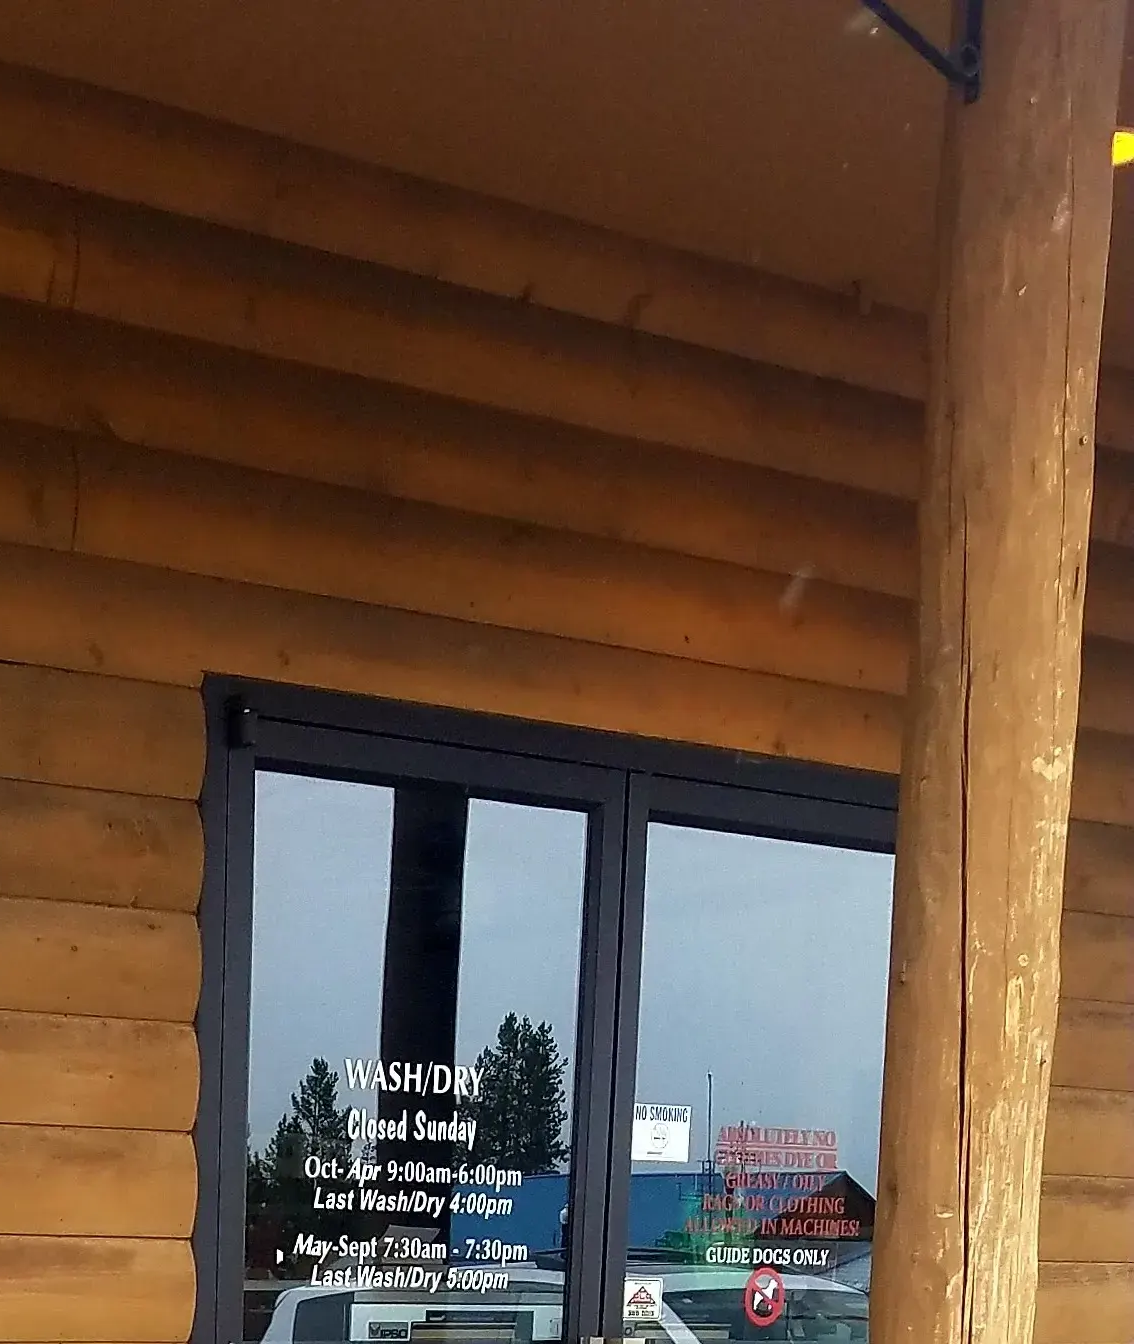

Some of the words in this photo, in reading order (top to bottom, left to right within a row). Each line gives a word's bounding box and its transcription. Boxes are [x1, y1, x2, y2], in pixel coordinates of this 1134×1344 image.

[344, 1058, 485, 1097] WASH/DRY
[635, 1105, 647, 1121] NO
[650, 1106, 688, 1123] SMOKING
[347, 1108, 407, 1142] Closed
[413, 1109, 477, 1151] Sunday
[313, 1187, 354, 1210] Last
[360, 1189, 446, 1219] Wash/Dry
[449, 1192, 513, 1219] 4:00pm
[745, 1195, 765, 1212] OR
[769, 1195, 846, 1215] CLOTHING
[760, 1218, 778, 1236] IN
[780, 1218, 861, 1238] MACHINES!
[292, 1233, 378, 1265] May-Sept
[382, 1236, 447, 1260] 7:30am
[464, 1238, 528, 1268] 7:30pm
[706, 1247, 750, 1265] GUIDE
[753, 1248, 791, 1266] DOGS
[793, 1249, 830, 1267] ONLY
[311, 1265, 350, 1288] Last
[356, 1266, 442, 1293] Wash/Dry
[446, 1268, 509, 1294] 5:00pm
